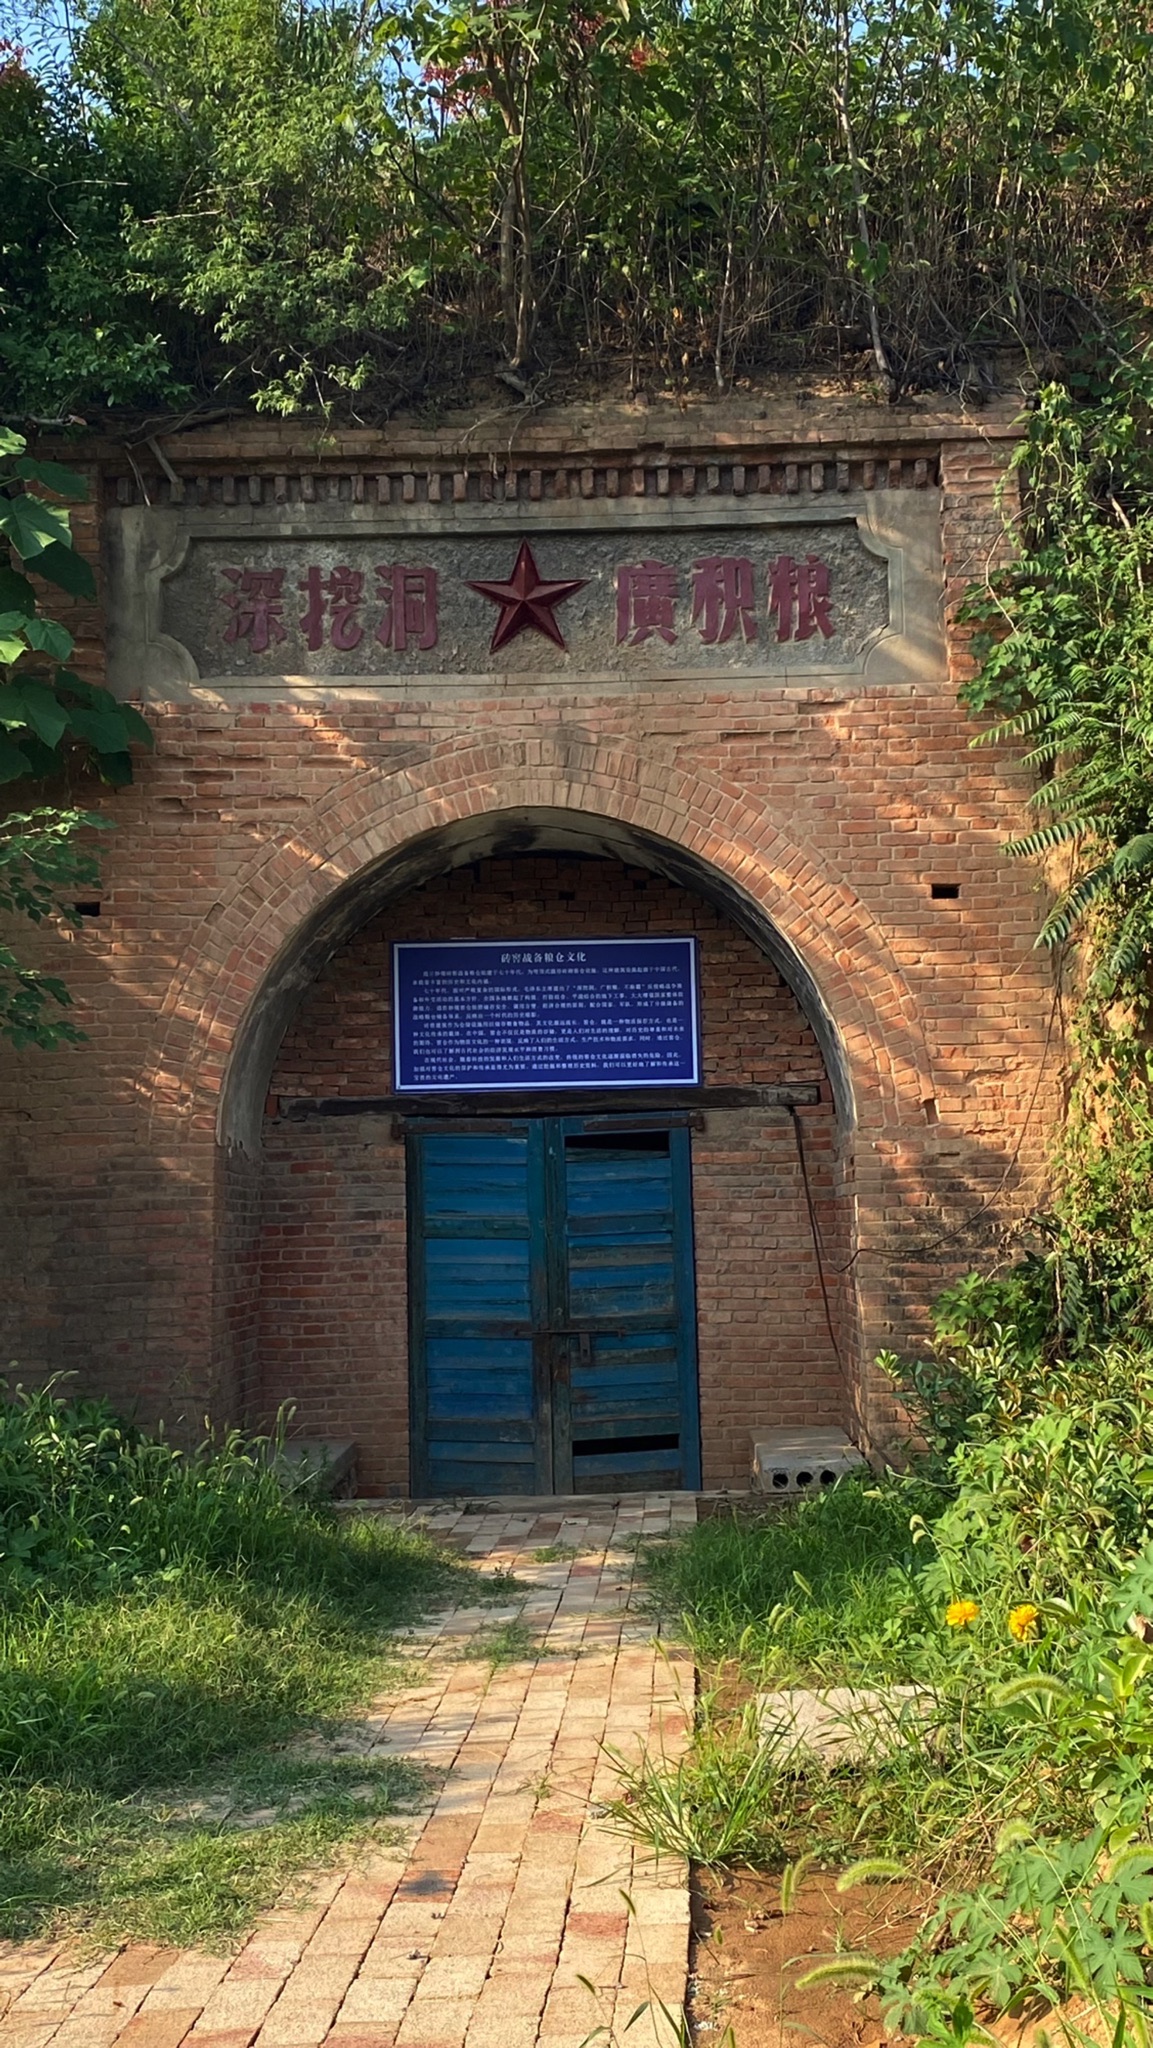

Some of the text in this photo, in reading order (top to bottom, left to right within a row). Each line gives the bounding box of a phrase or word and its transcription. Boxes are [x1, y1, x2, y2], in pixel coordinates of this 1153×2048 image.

[219, 554, 835, 653] 深挖洞 廣积粮
[501, 952, 587, 963] 砖窑战备粮仓文化
